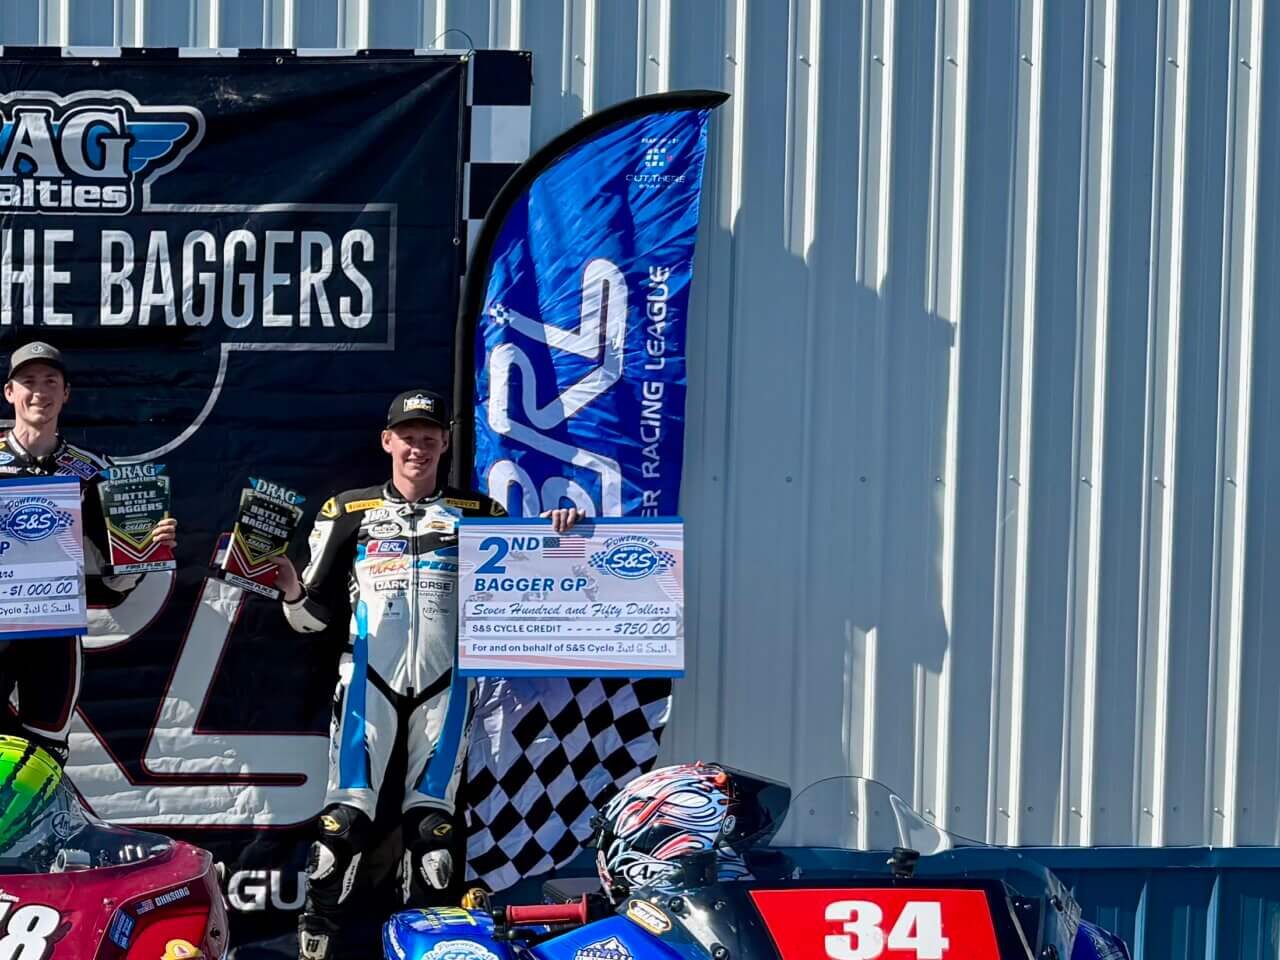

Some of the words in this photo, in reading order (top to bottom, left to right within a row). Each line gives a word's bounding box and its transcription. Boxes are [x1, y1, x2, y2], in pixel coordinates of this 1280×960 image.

[100, 229, 376, 329] BAGGERS
[644, 265, 670, 371] LEAGUE
[640, 381, 665, 478] RACING
[109, 464, 156, 480] DRAG
[113, 490, 157, 502] BATTLE
[255, 478, 297, 505] DRAG
[109, 502, 163, 515] BAGGERS
[250, 504, 288, 525] BATTLE
[13, 512, 53, 531] S&S
[241, 514, 289, 539] BAGGERS
[379, 542, 402, 552] BRL
[603, 535, 644, 547] POWERED
[474, 535, 540, 575] 2ND
[611, 553, 652, 568] S&S
[376, 581, 409, 590] DARK
[473, 578, 555, 592] BAGGER
[560, 578, 587, 592] GP
[472, 603, 506, 616] Seven
[509, 602, 562, 616] Hundred
[564, 603, 587, 616] and
[591, 603, 621, 619] Fifty
[625, 602, 671, 616] Dollars
[472, 624, 492, 633] S&S
[493, 624, 524, 633] CYCLE
[526, 624, 562, 633] CREDIT
[613, 622, 671, 635] $750.00
[472, 643, 487, 652] For
[488, 643, 508, 652] and
[522, 643, 553, 652] behalf
[554, 643, 564, 652] of
[566, 643, 585, 652] S&S
[587, 643, 615, 653] Cycle
